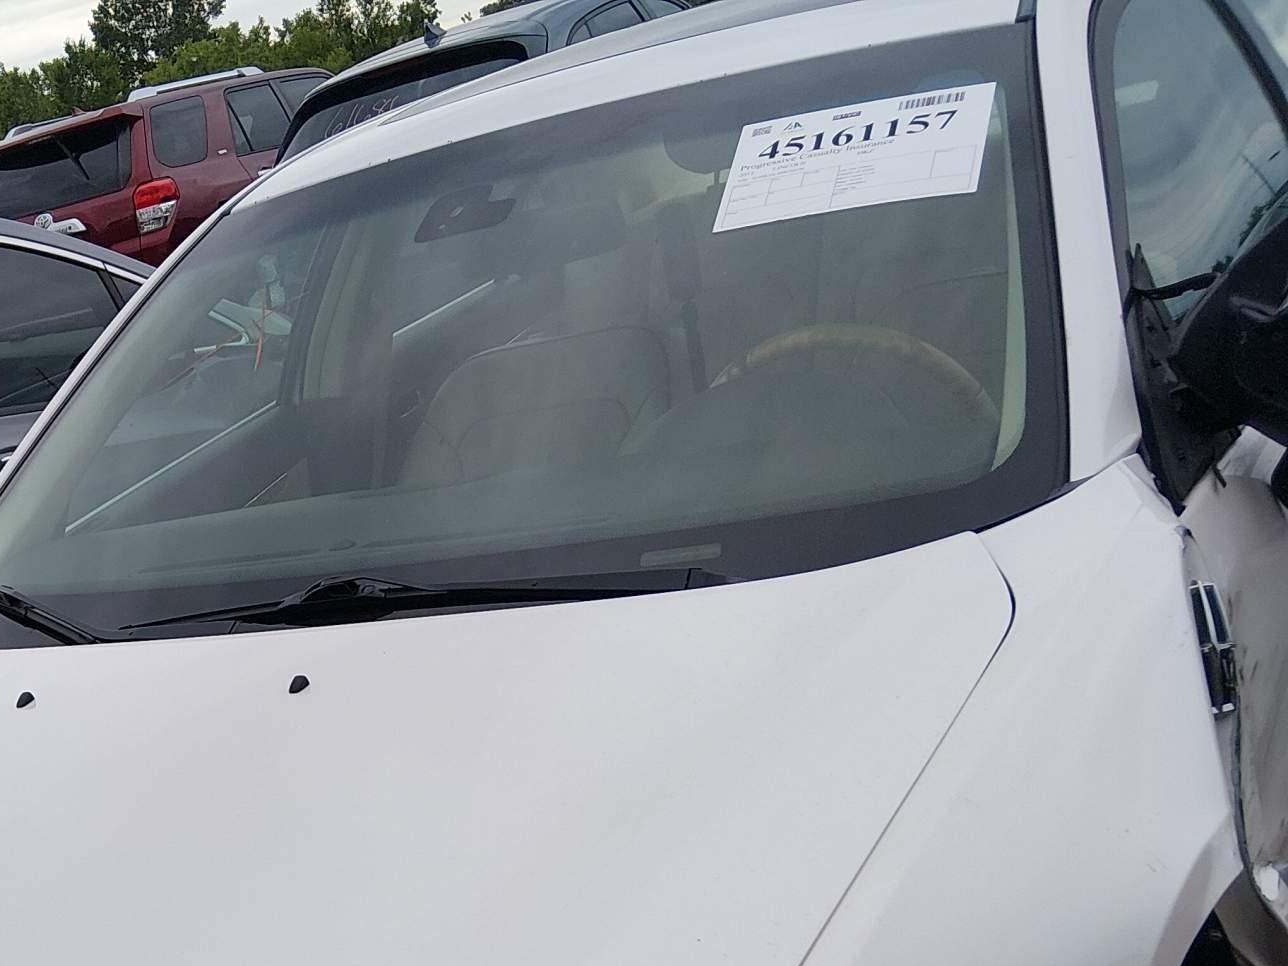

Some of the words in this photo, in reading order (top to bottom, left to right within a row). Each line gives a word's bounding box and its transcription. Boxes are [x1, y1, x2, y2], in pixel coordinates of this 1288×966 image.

[758, 110, 958, 159] 45161157
[740, 156, 796, 172] Progressive
[799, 147, 842, 161] Casualty
[846, 139, 895, 152] Insurance
